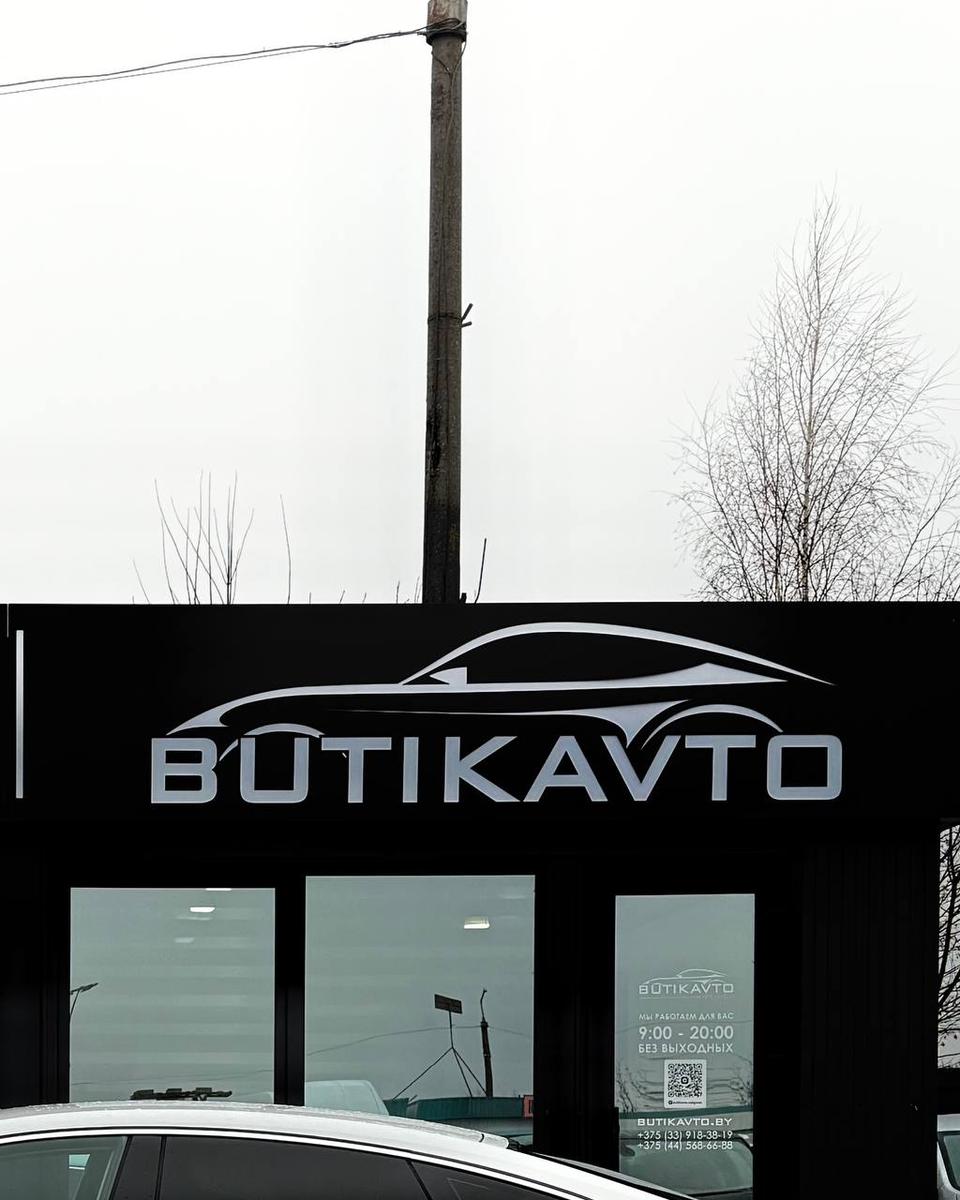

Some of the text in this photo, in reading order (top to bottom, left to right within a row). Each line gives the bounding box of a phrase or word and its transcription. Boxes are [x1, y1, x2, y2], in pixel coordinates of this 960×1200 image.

[151, 735, 843, 804] BUTIKAVTO
[638, 983, 734, 995] BUTIKAVTO
[717, 1012, 734, 1020] ВАС
[639, 1026, 672, 1040] 9:00
[689, 1025, 734, 1040] 20:00
[638, 1043, 734, 1054] БЕЗ ВЫХОДНЫХ
[637, 1118, 733, 1126] BUTIKAVTO.BY
[638, 1130, 733, 1141] +375 (33) 918-38-19
[638, 1141, 733, 1152] +375 (44) 568-66-88
